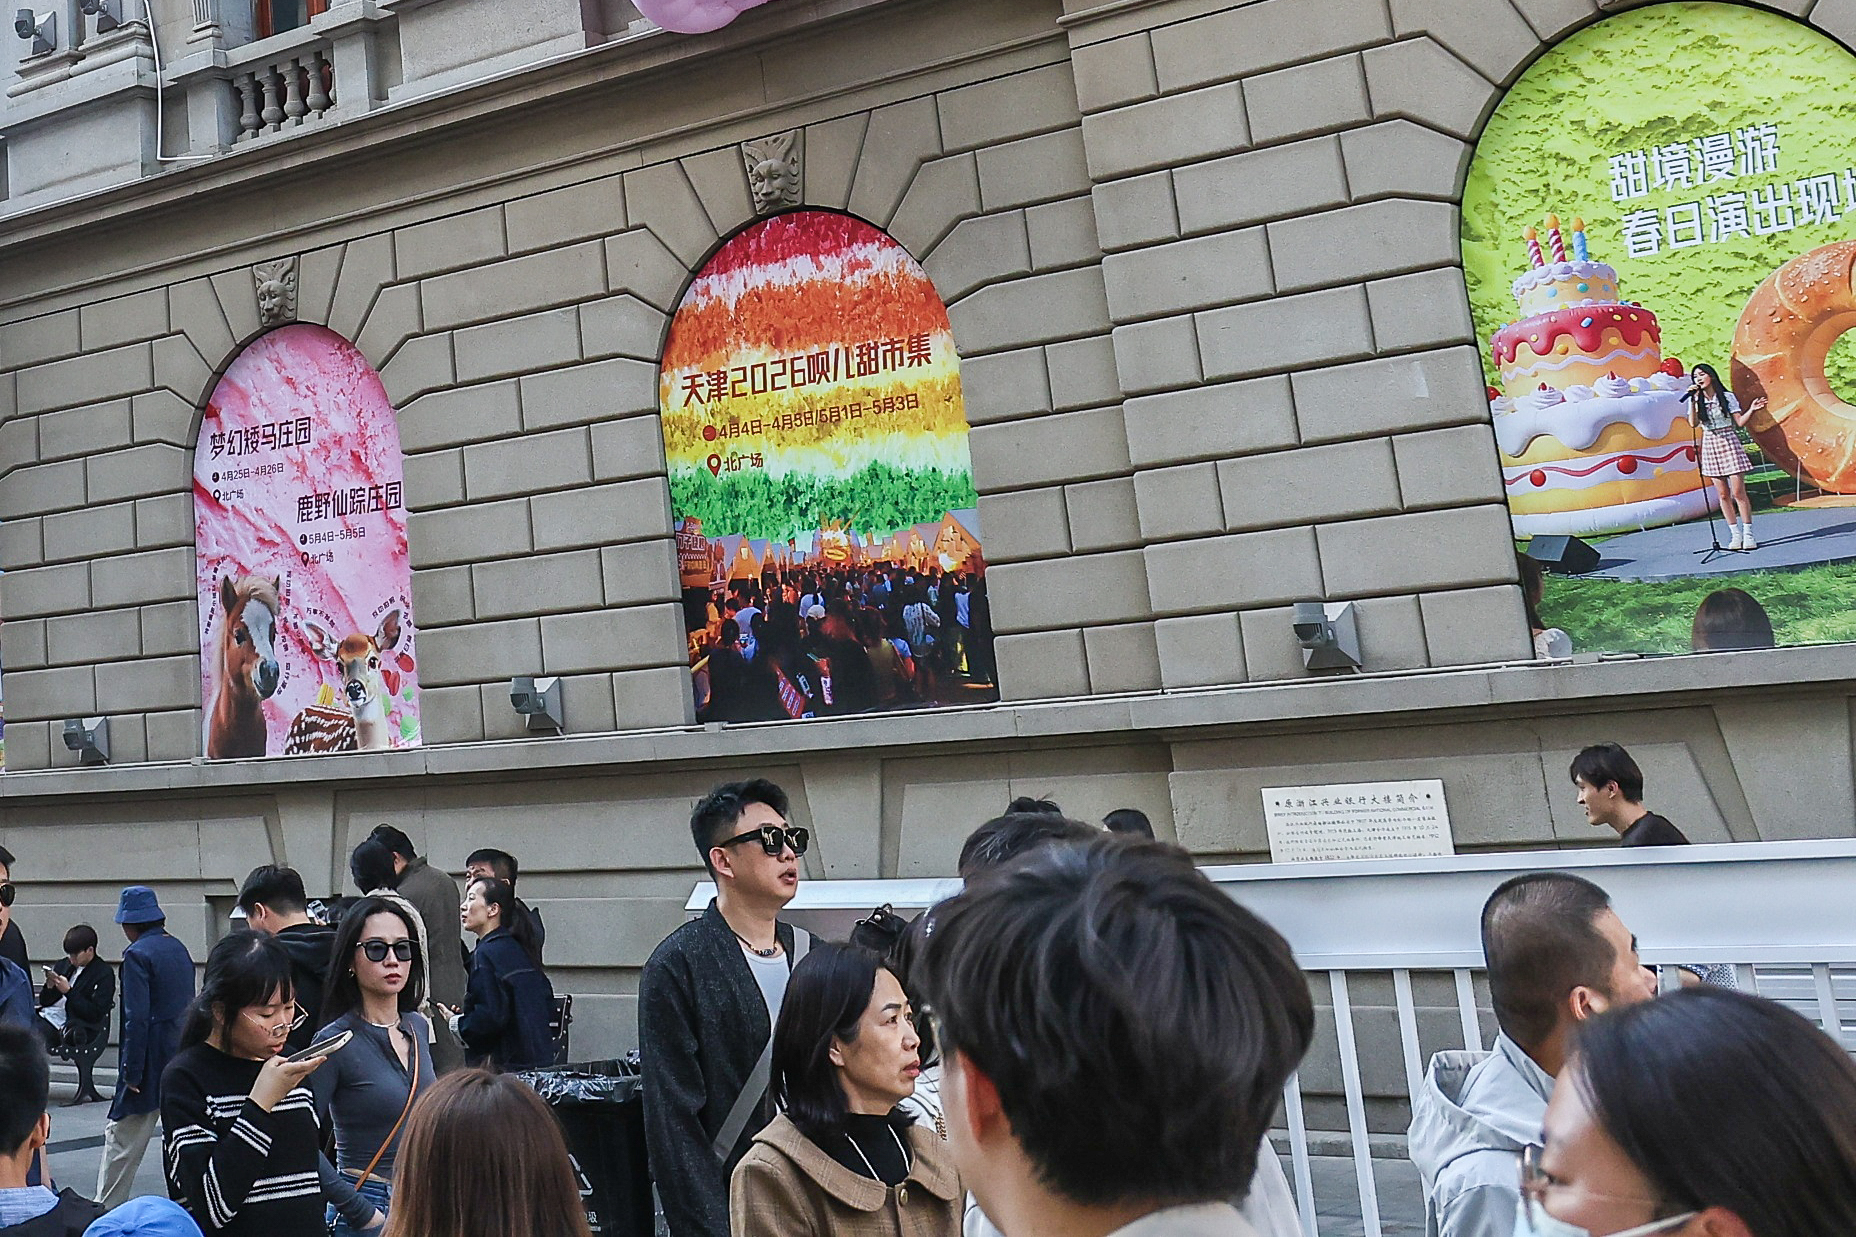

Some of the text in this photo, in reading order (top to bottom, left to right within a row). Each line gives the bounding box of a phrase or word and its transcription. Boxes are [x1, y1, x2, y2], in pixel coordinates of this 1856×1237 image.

[1608, 122, 1781, 202] 甜境漫游
[1621, 167, 1856, 260] 春日演出现
[681, 332, 933, 408] 天津2026呗儿甜市集
[209, 416, 312, 461] 梦幻矮马庄园
[723, 452, 764, 473] 北广场
[222, 488, 244, 502] 北广场
[296, 480, 402, 524] 鹿野仙踪庄园
[310, 551, 334, 564] 北广场
